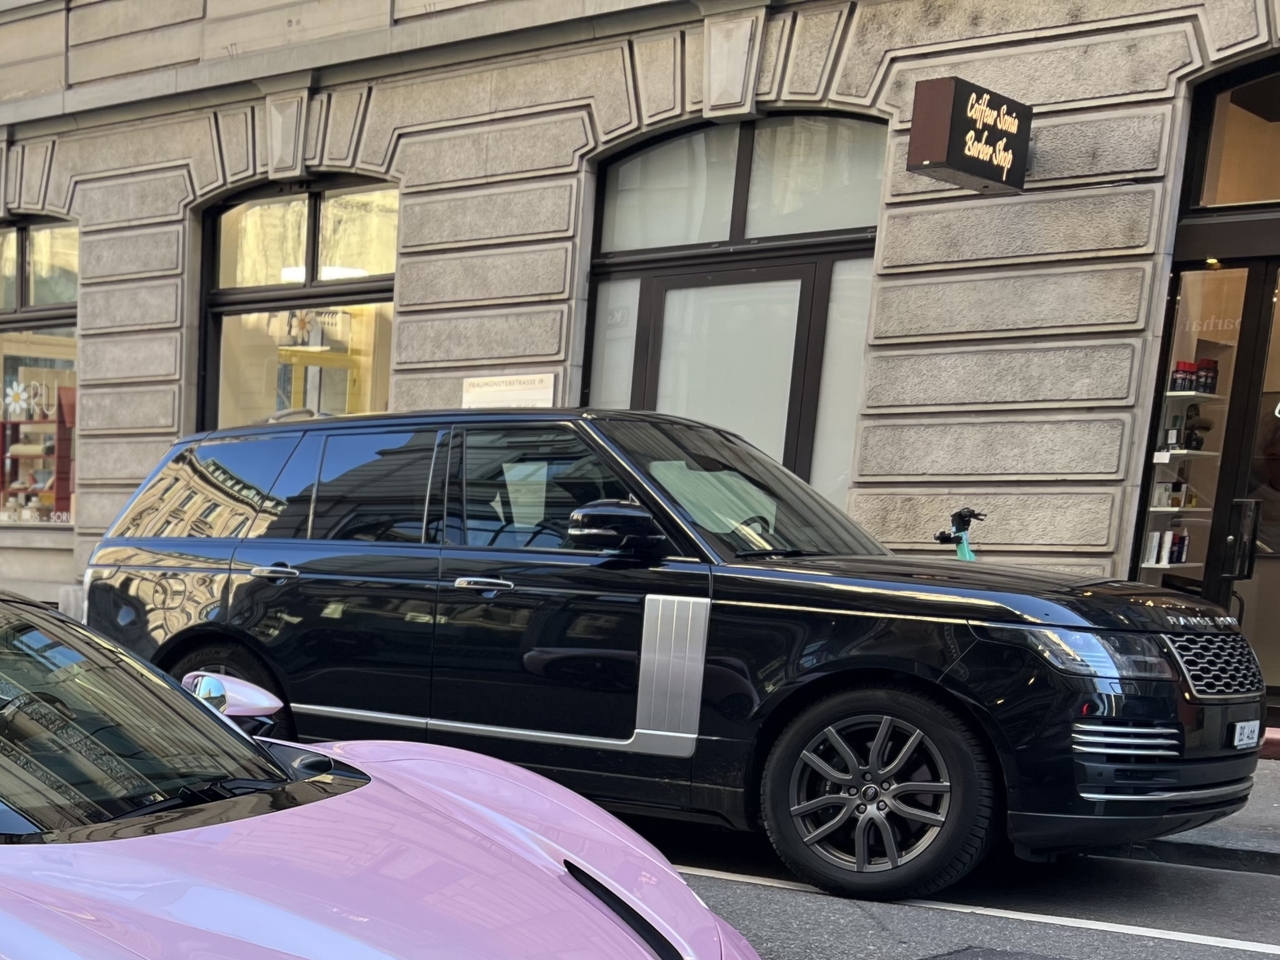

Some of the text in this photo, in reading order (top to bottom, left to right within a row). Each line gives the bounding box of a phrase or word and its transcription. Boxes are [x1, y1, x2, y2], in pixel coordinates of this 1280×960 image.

[967, 92, 1018, 134] Coiffeur Sonia
[964, 130, 1013, 181] Barber Shop
[469, 379, 536, 388] FRAUMÜNSTERSTRASSE
[1166, 616, 1214, 626] RANGE
